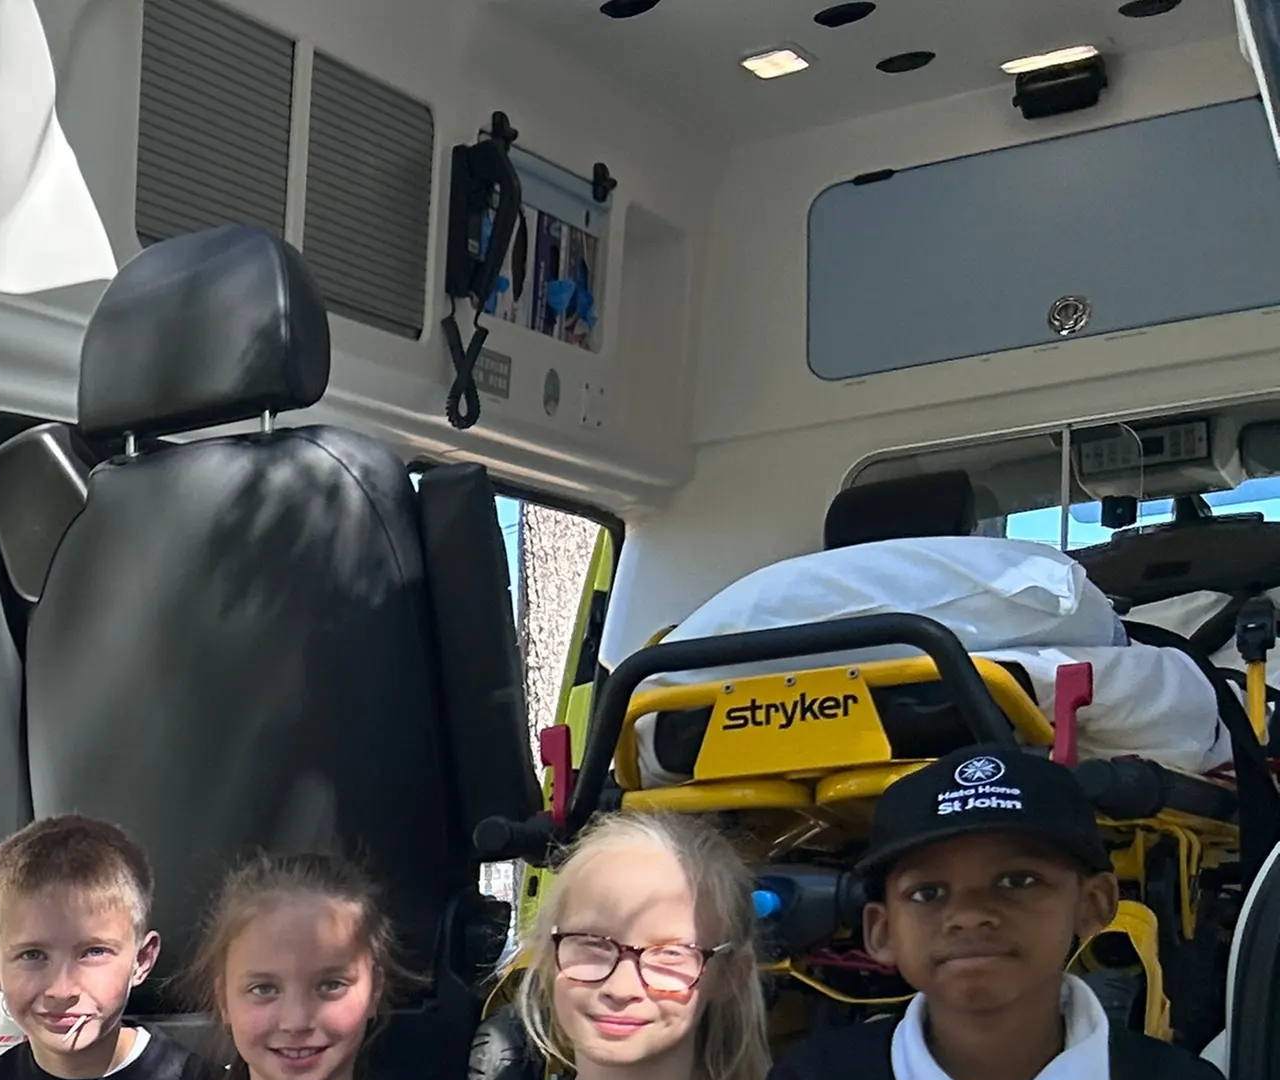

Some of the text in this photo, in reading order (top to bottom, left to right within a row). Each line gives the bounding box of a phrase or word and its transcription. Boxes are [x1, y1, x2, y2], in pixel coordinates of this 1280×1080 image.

[722, 692, 859, 731] stryker
[937, 796, 1022, 815] St John
